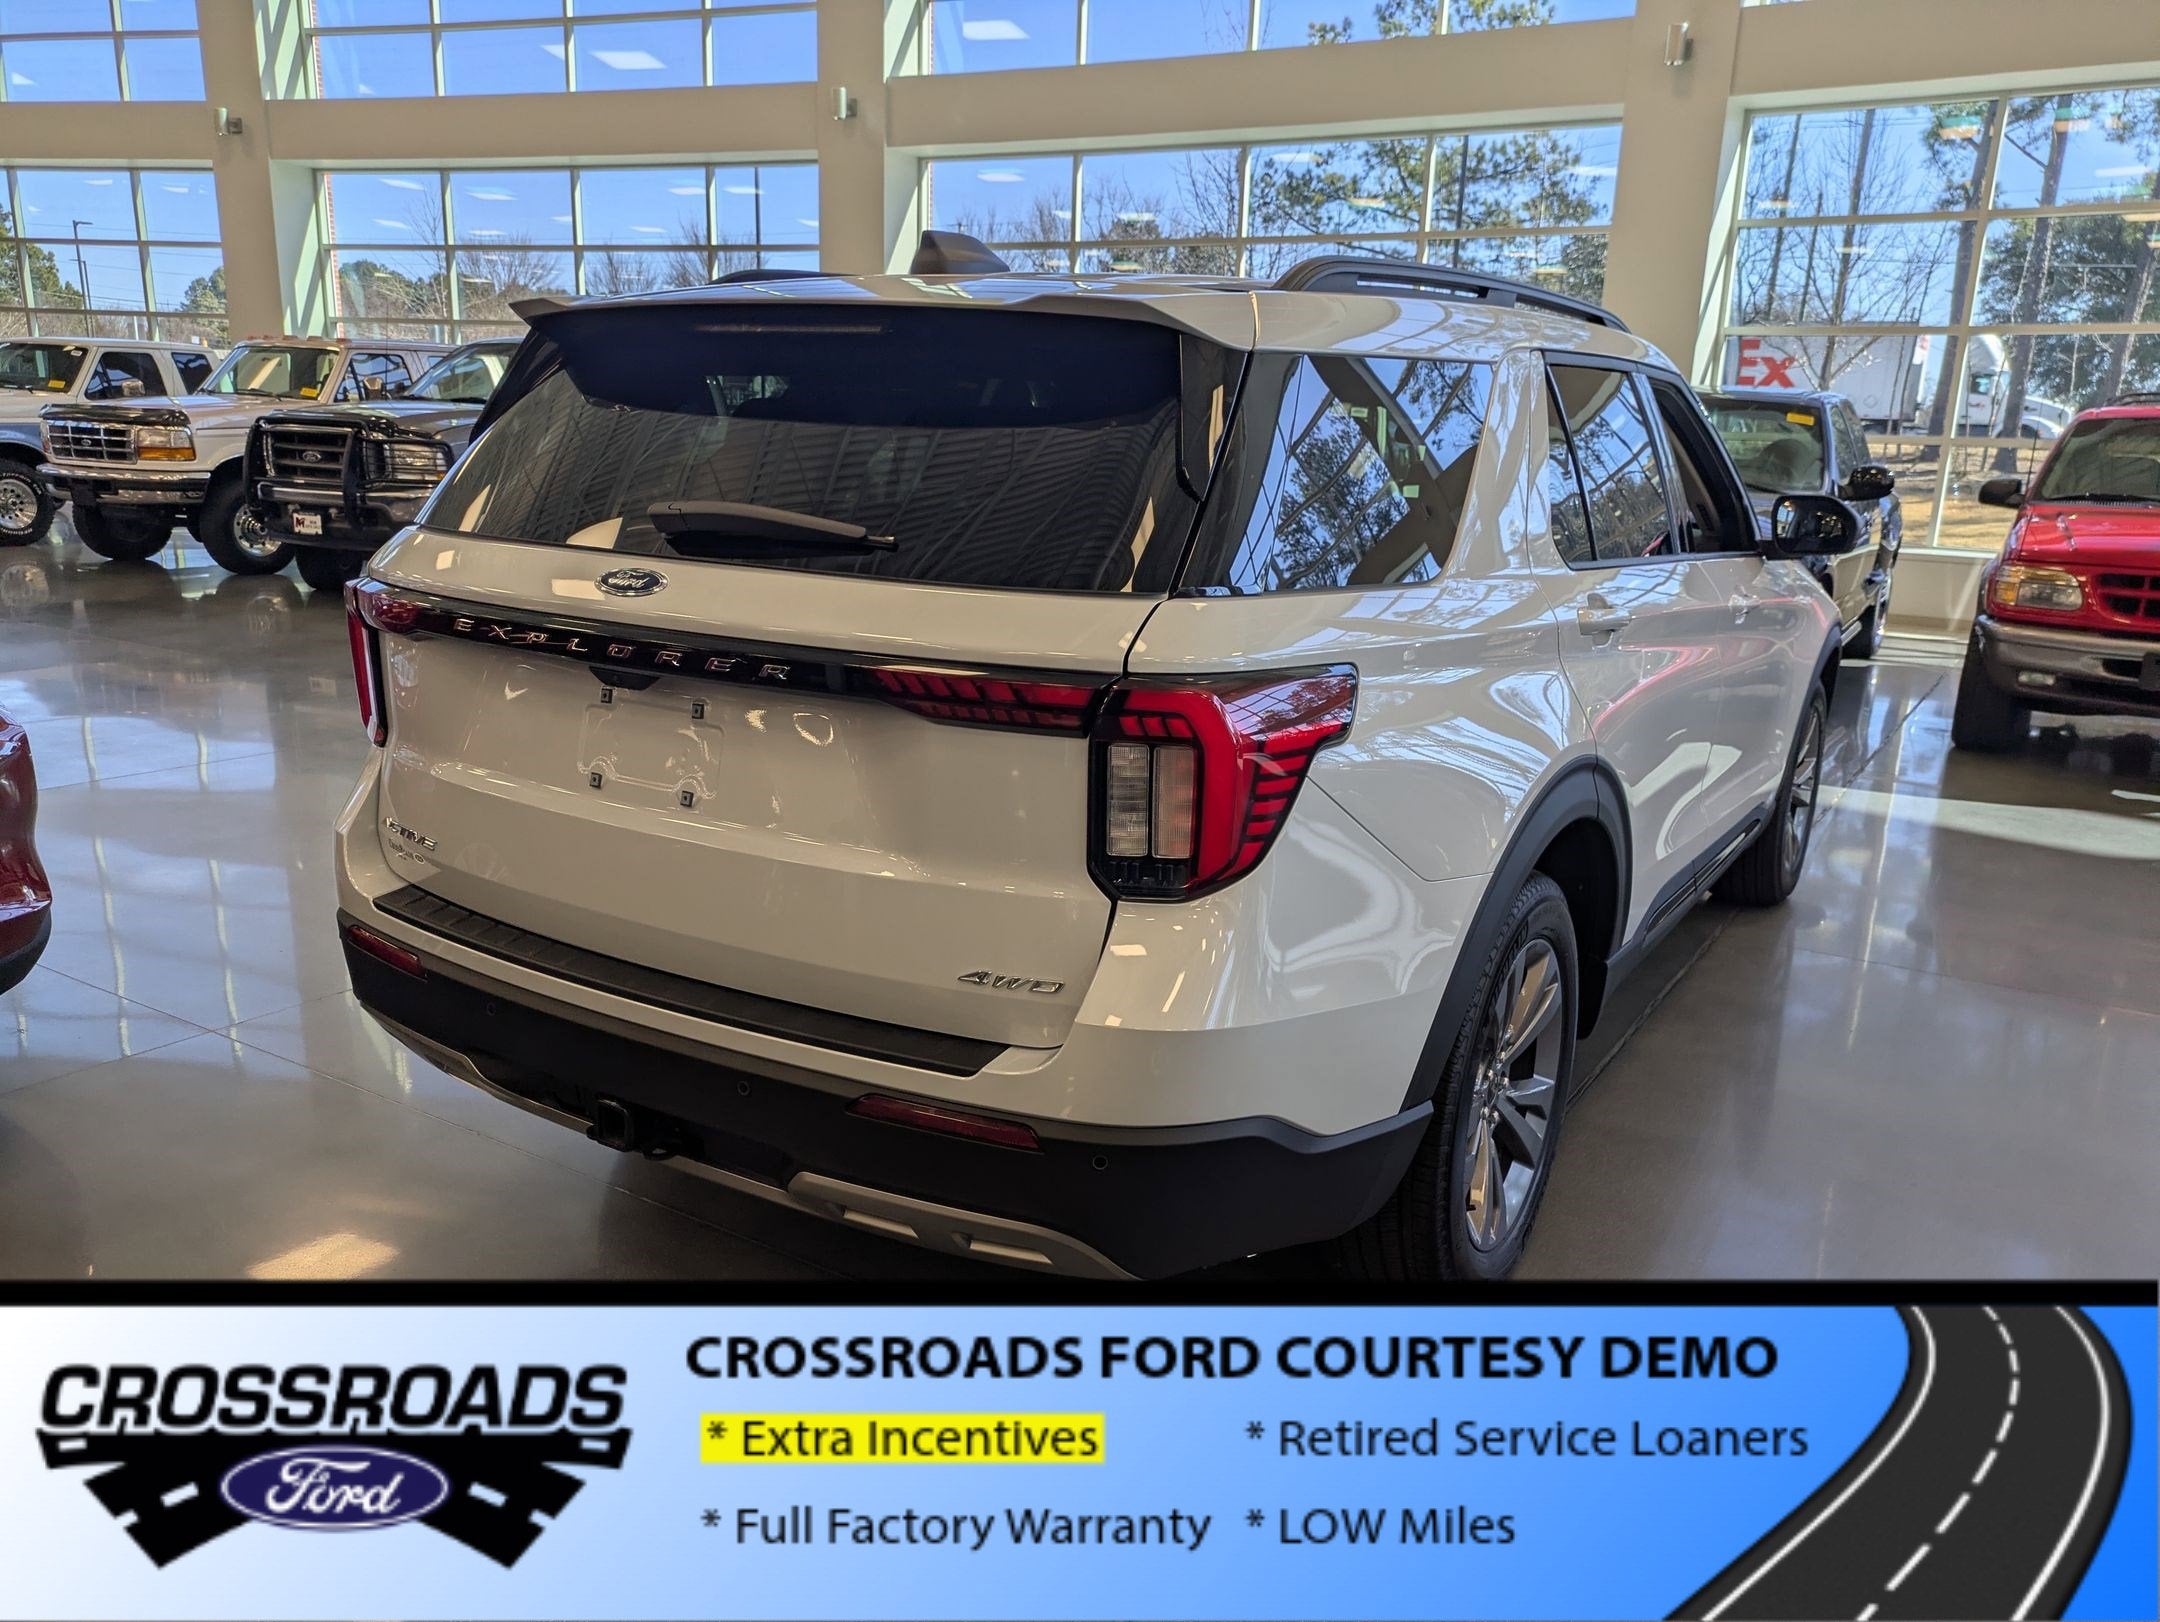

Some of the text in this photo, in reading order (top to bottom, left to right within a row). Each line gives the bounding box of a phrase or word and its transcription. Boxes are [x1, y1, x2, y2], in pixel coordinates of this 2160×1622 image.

[607, 570, 651, 589] Ford
[452, 617, 790, 682] EXPLORER
[957, 969, 1066, 995] 4WD
